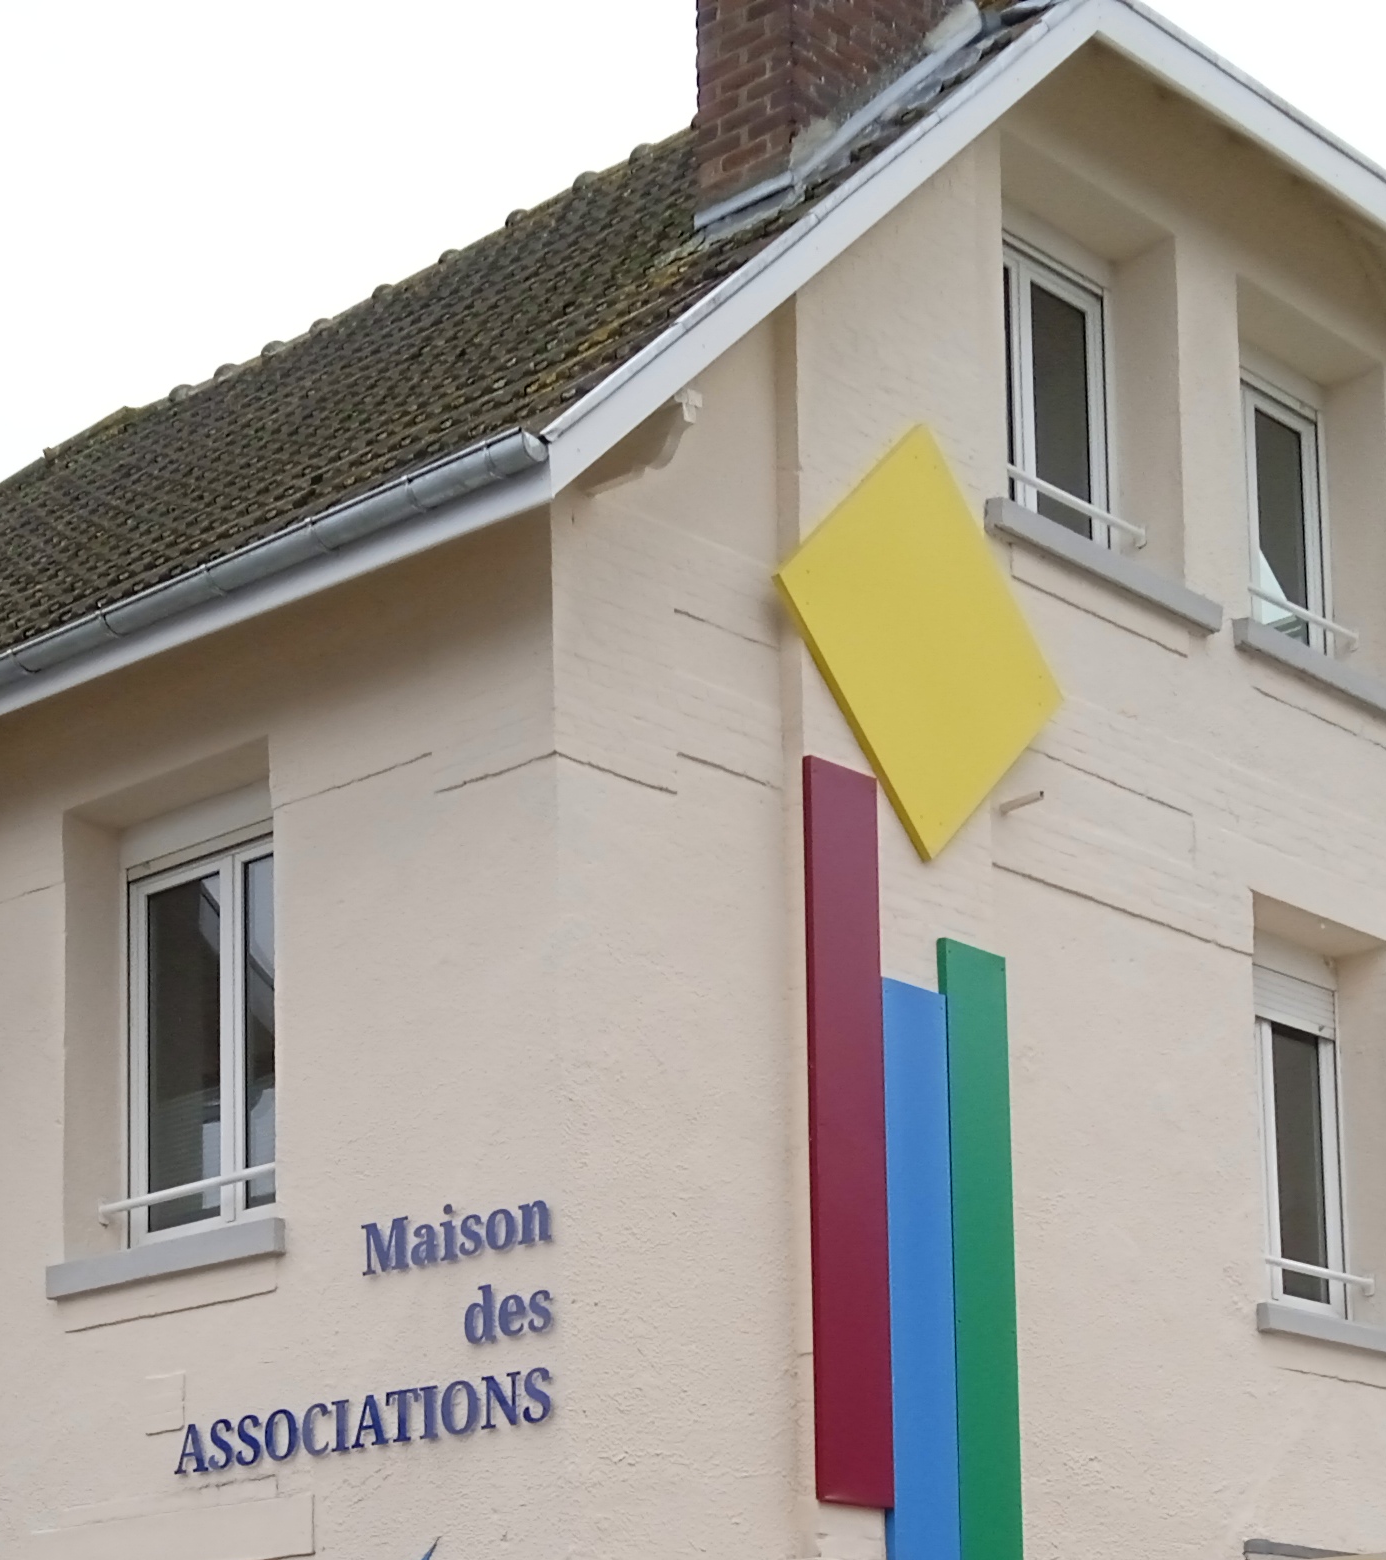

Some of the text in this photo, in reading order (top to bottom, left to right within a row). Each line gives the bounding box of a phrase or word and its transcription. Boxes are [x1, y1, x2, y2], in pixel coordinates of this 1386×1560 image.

[362, 1198, 552, 1276] Maison
[463, 1284, 552, 1345] des
[174, 1366, 552, 1475] ASSOCIATIONS
